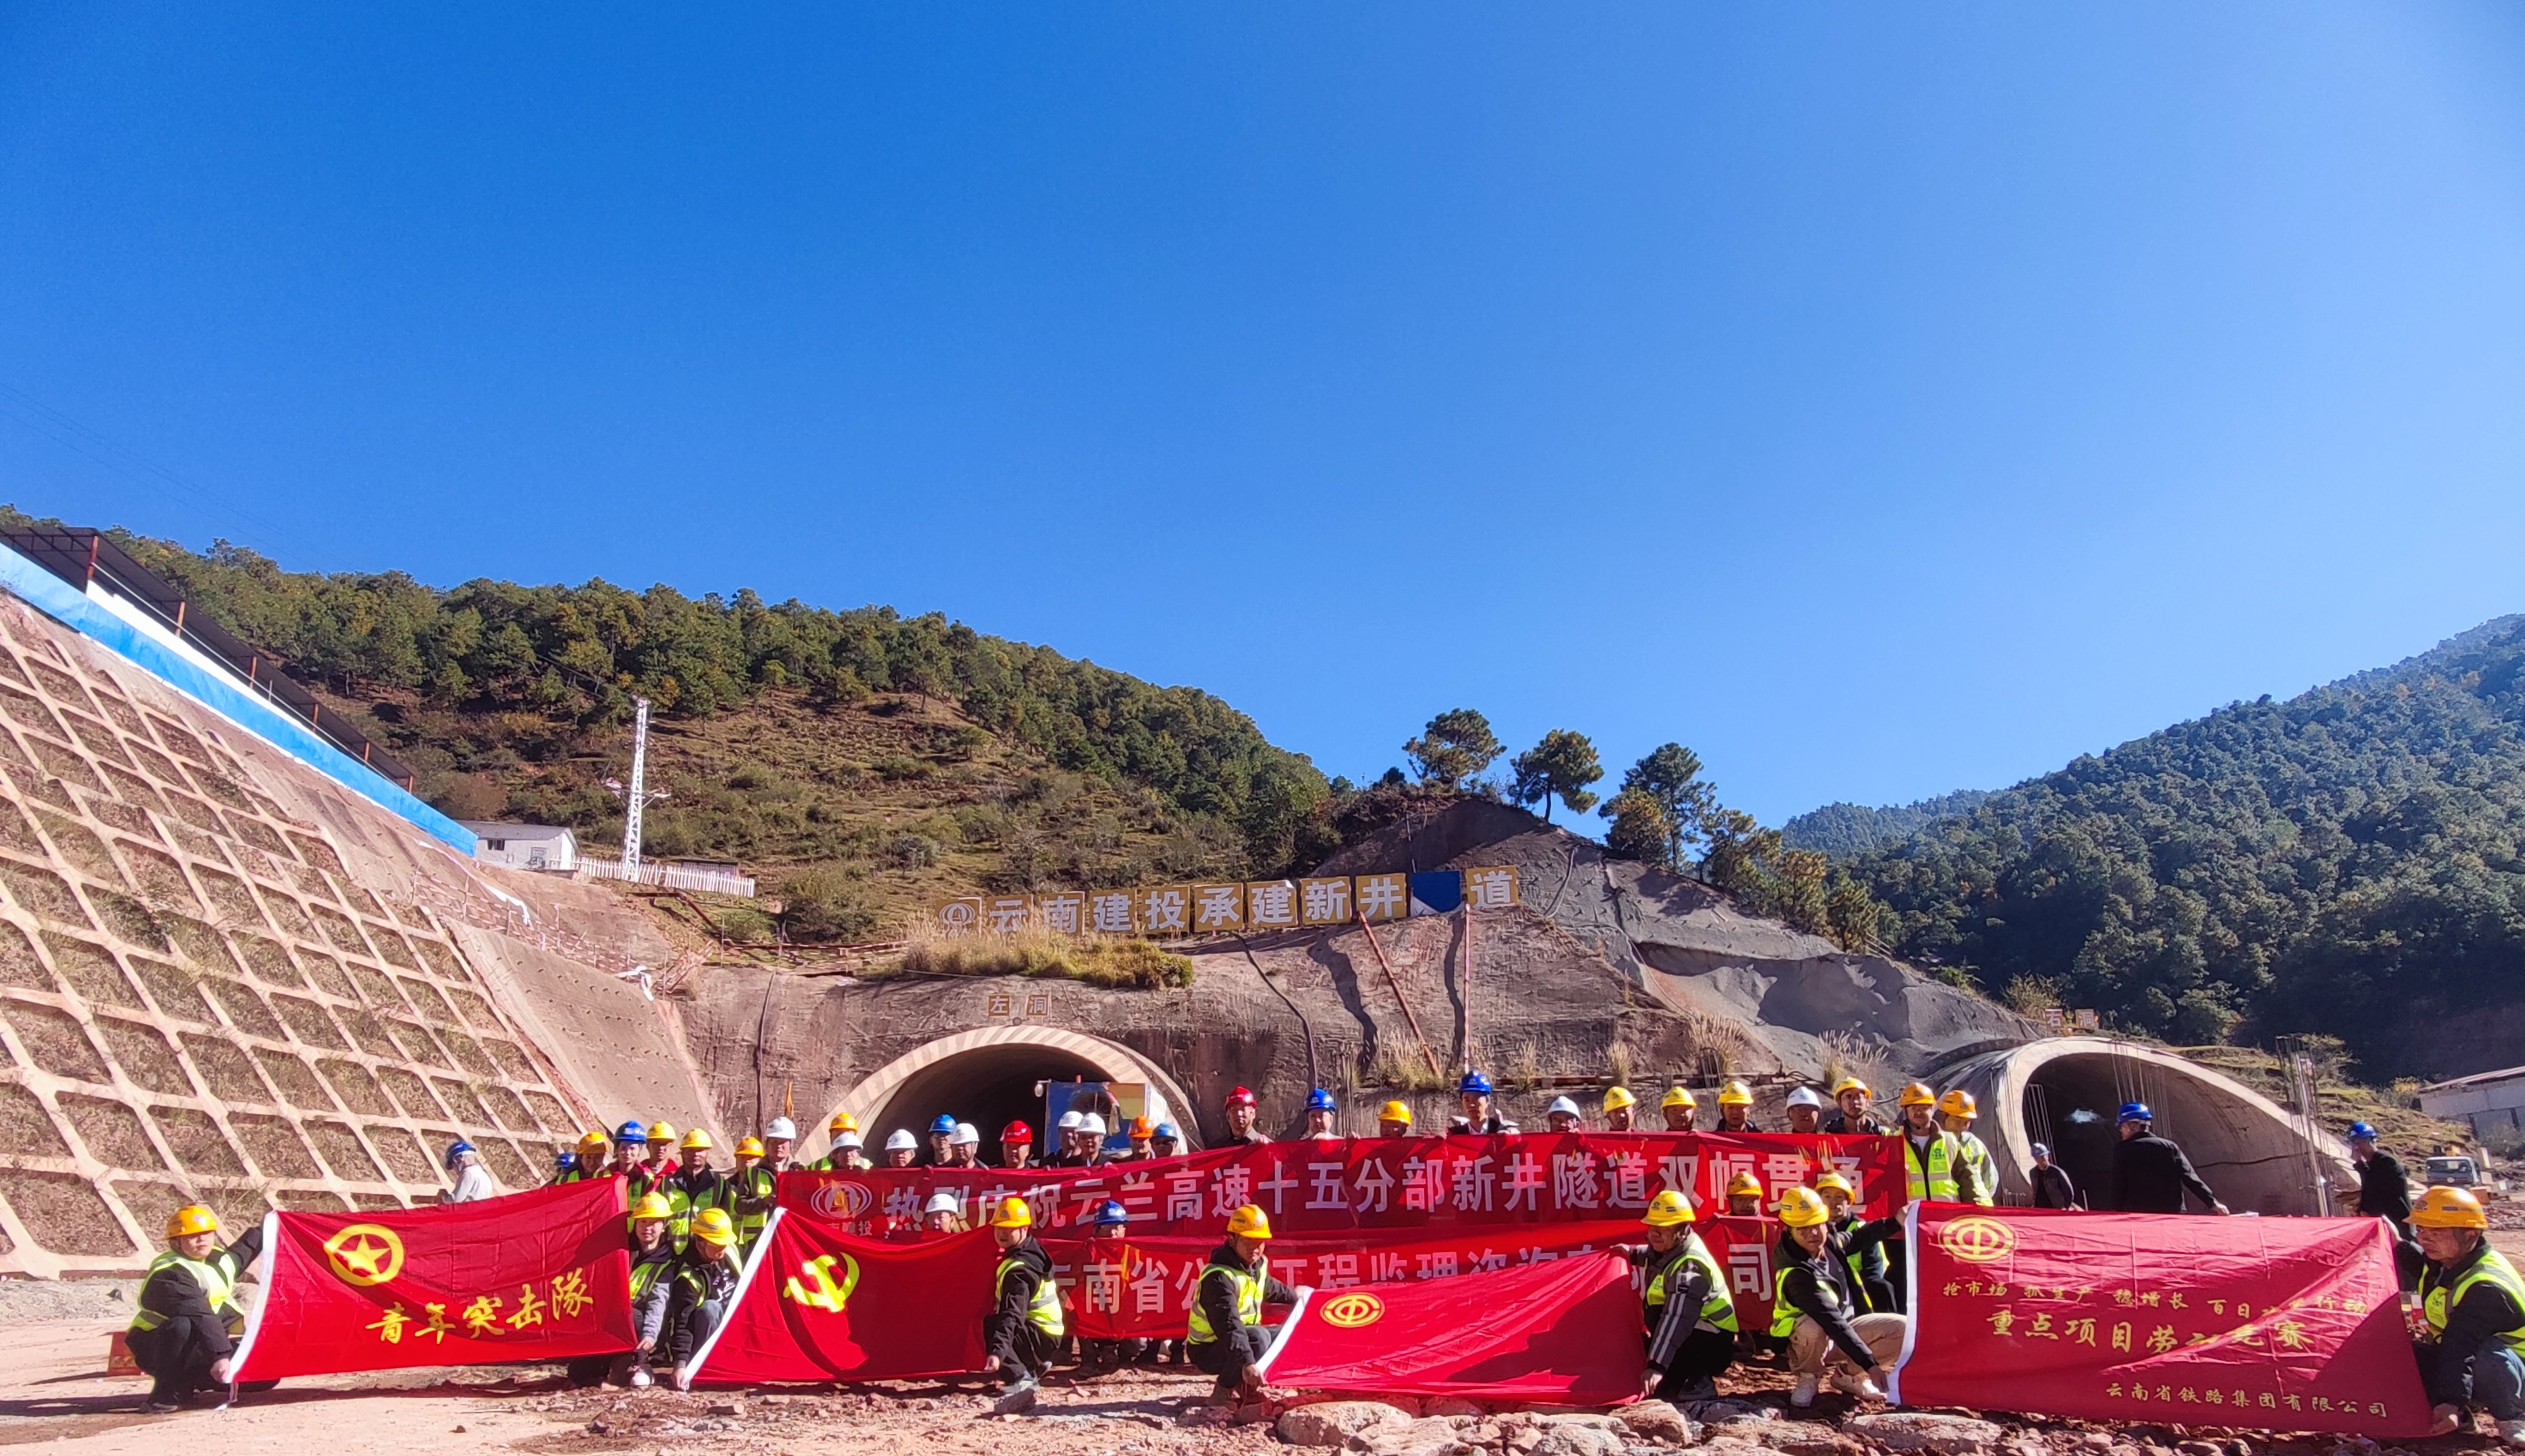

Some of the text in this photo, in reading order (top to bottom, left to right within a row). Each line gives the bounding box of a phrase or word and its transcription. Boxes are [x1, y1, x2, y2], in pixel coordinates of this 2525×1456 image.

[989, 870, 1516, 933] 云南建投承建新井道
[989, 996, 1048, 1015] 左洞
[1943, 1281, 2008, 1297] 抢市场
[2024, 1285, 2093, 1302] 抓生产
[2113, 1288, 2189, 1310] 稳增长
[2106, 1383, 2387, 1418] 云南省铁路集团有限公司
